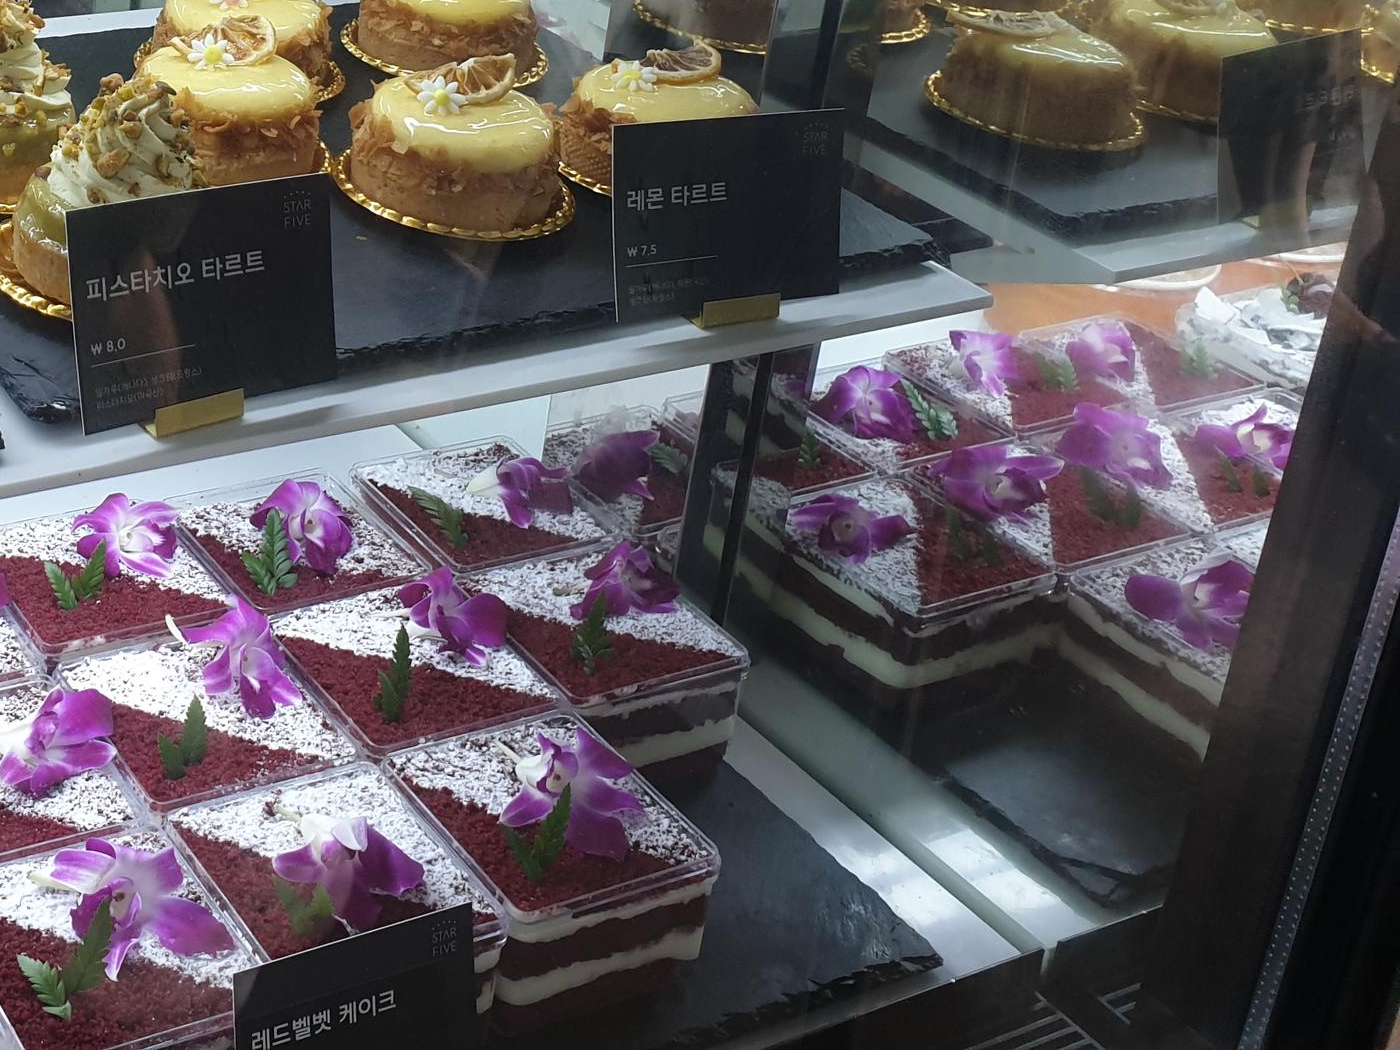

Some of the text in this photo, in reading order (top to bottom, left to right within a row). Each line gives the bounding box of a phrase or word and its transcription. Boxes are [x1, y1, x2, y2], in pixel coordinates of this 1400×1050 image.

[283, 199, 311, 214] STAR
[626, 181, 728, 211] 레몬 타르트
[284, 213, 311, 228] FIVE
[86, 250, 266, 301] 피스타치오 타르트
[106, 337, 126, 352] 8.0
[251, 989, 396, 1050] 레드벨벳 케이크
